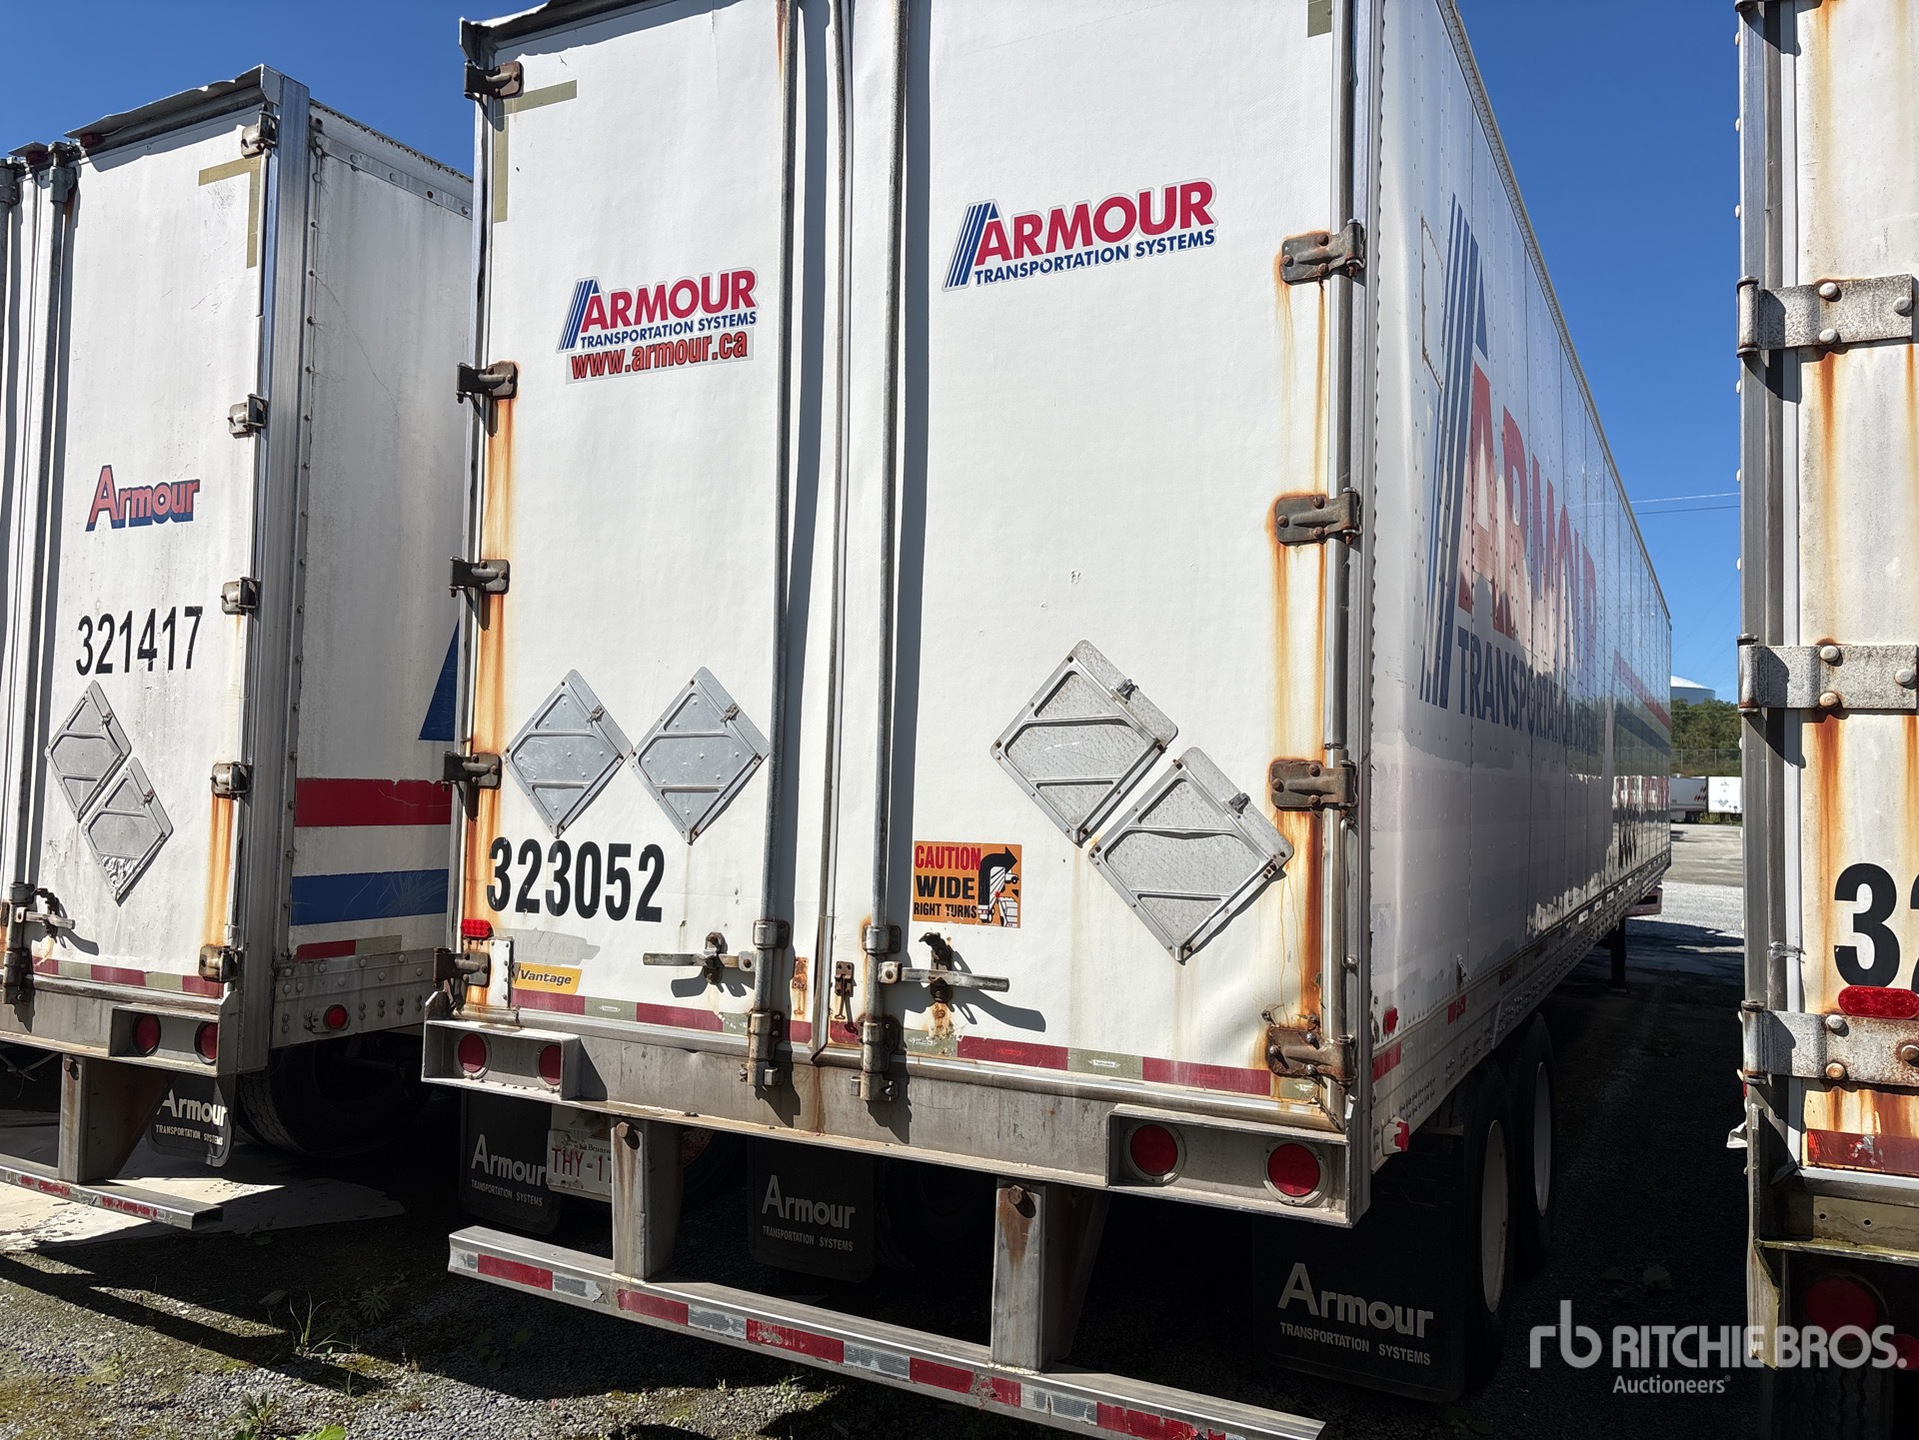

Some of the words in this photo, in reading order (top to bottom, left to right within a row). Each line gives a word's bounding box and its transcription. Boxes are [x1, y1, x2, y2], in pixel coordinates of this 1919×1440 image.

[974, 181, 1215, 267] ARMOUR
[974, 244, 1129, 286] TRANSPORTATION
[1136, 229, 1215, 258] SYSTEMS
[579, 270, 757, 333] ARMOUR
[581, 320, 693, 350] TRANSPORTATION
[698, 311, 757, 332] SYSTEMS
[571, 331, 748, 380] www.armour.ca
[85, 464, 201, 532] Armour
[75, 606, 203, 677] 321417
[487, 836, 664, 923] 323052
[914, 844, 982, 871] CAUTION
[913, 902, 942, 917] RIGHT
[945, 903, 978, 919] TURNS
[916, 875, 976, 900] WIDE
[1833, 863, 1919, 988] 3
[521, 969, 572, 986] Vantage
[156, 1088, 229, 1127] Armour
[155, 1124, 201, 1140] TRANSPORTATION
[203, 1132, 224, 1147] SYSTEMS
[471, 1133, 547, 1187] Armour
[471, 1179, 513, 1200] TRANSPORTATION
[516, 1191, 543, 1207] SYSTEMS
[761, 1174, 856, 1230] Armour
[762, 1225, 815, 1245] TRANSPORTATION
[819, 1236, 854, 1252] SYSTEMS
[1277, 1262, 1434, 1339] Armour
[1279, 1321, 1370, 1353] TRANSPORTATION
[1378, 1343, 1431, 1366] SYSTEMS
